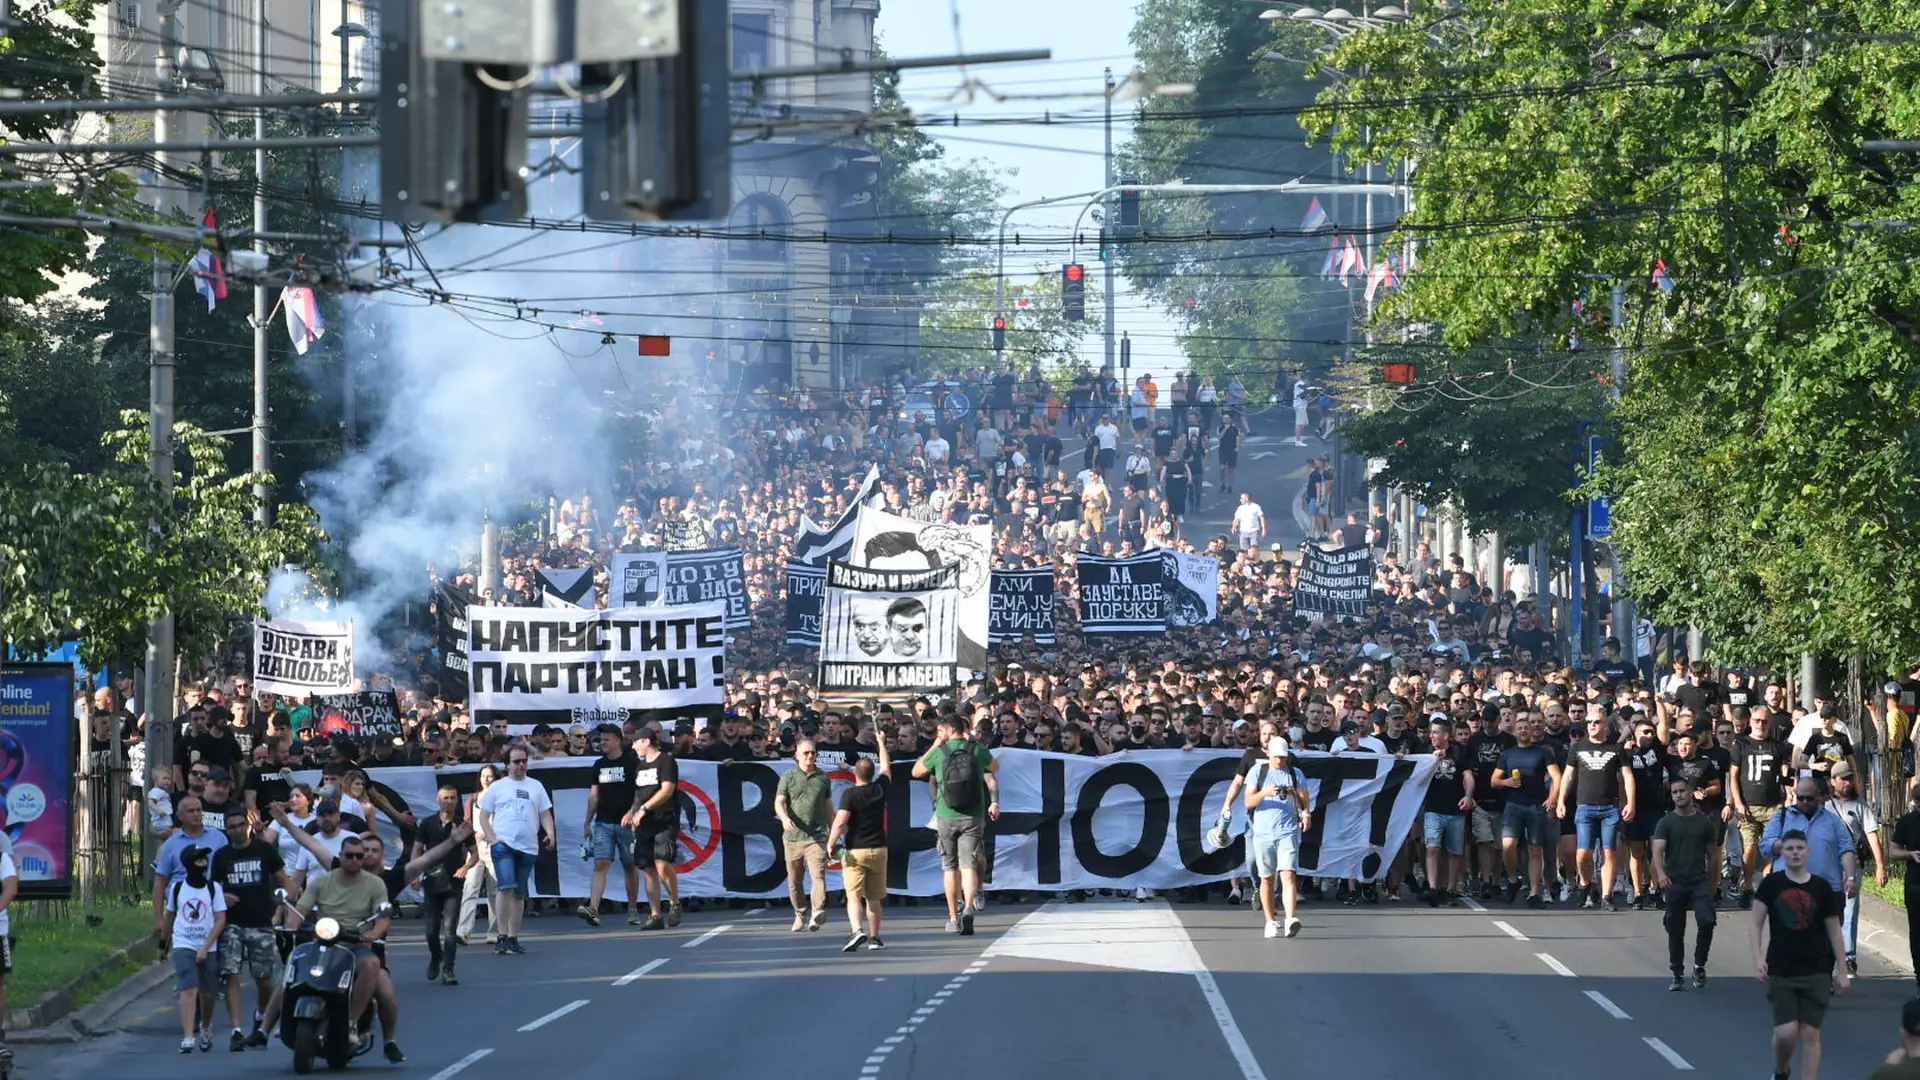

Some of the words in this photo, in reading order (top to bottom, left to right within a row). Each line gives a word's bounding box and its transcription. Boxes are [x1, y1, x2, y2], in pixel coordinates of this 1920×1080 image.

[888, 574, 899, 588] И
[998, 577, 1033, 593] АЛИ
[1109, 566, 1133, 585] ДА
[699, 578, 744, 600] НАС
[1081, 583, 1164, 601] ЗАУСТАВЕ
[1088, 601, 1158, 619] ПОРУКУ
[471, 616, 723, 652] НАПУСТИТЕ
[262, 631, 338, 660] УПРАВА
[258, 654, 339, 684] НАПОЉЕ
[472, 658, 697, 693] ПАРТИЗАН
[886, 666, 897, 686] И
[0, 700, 50, 715] endan!
